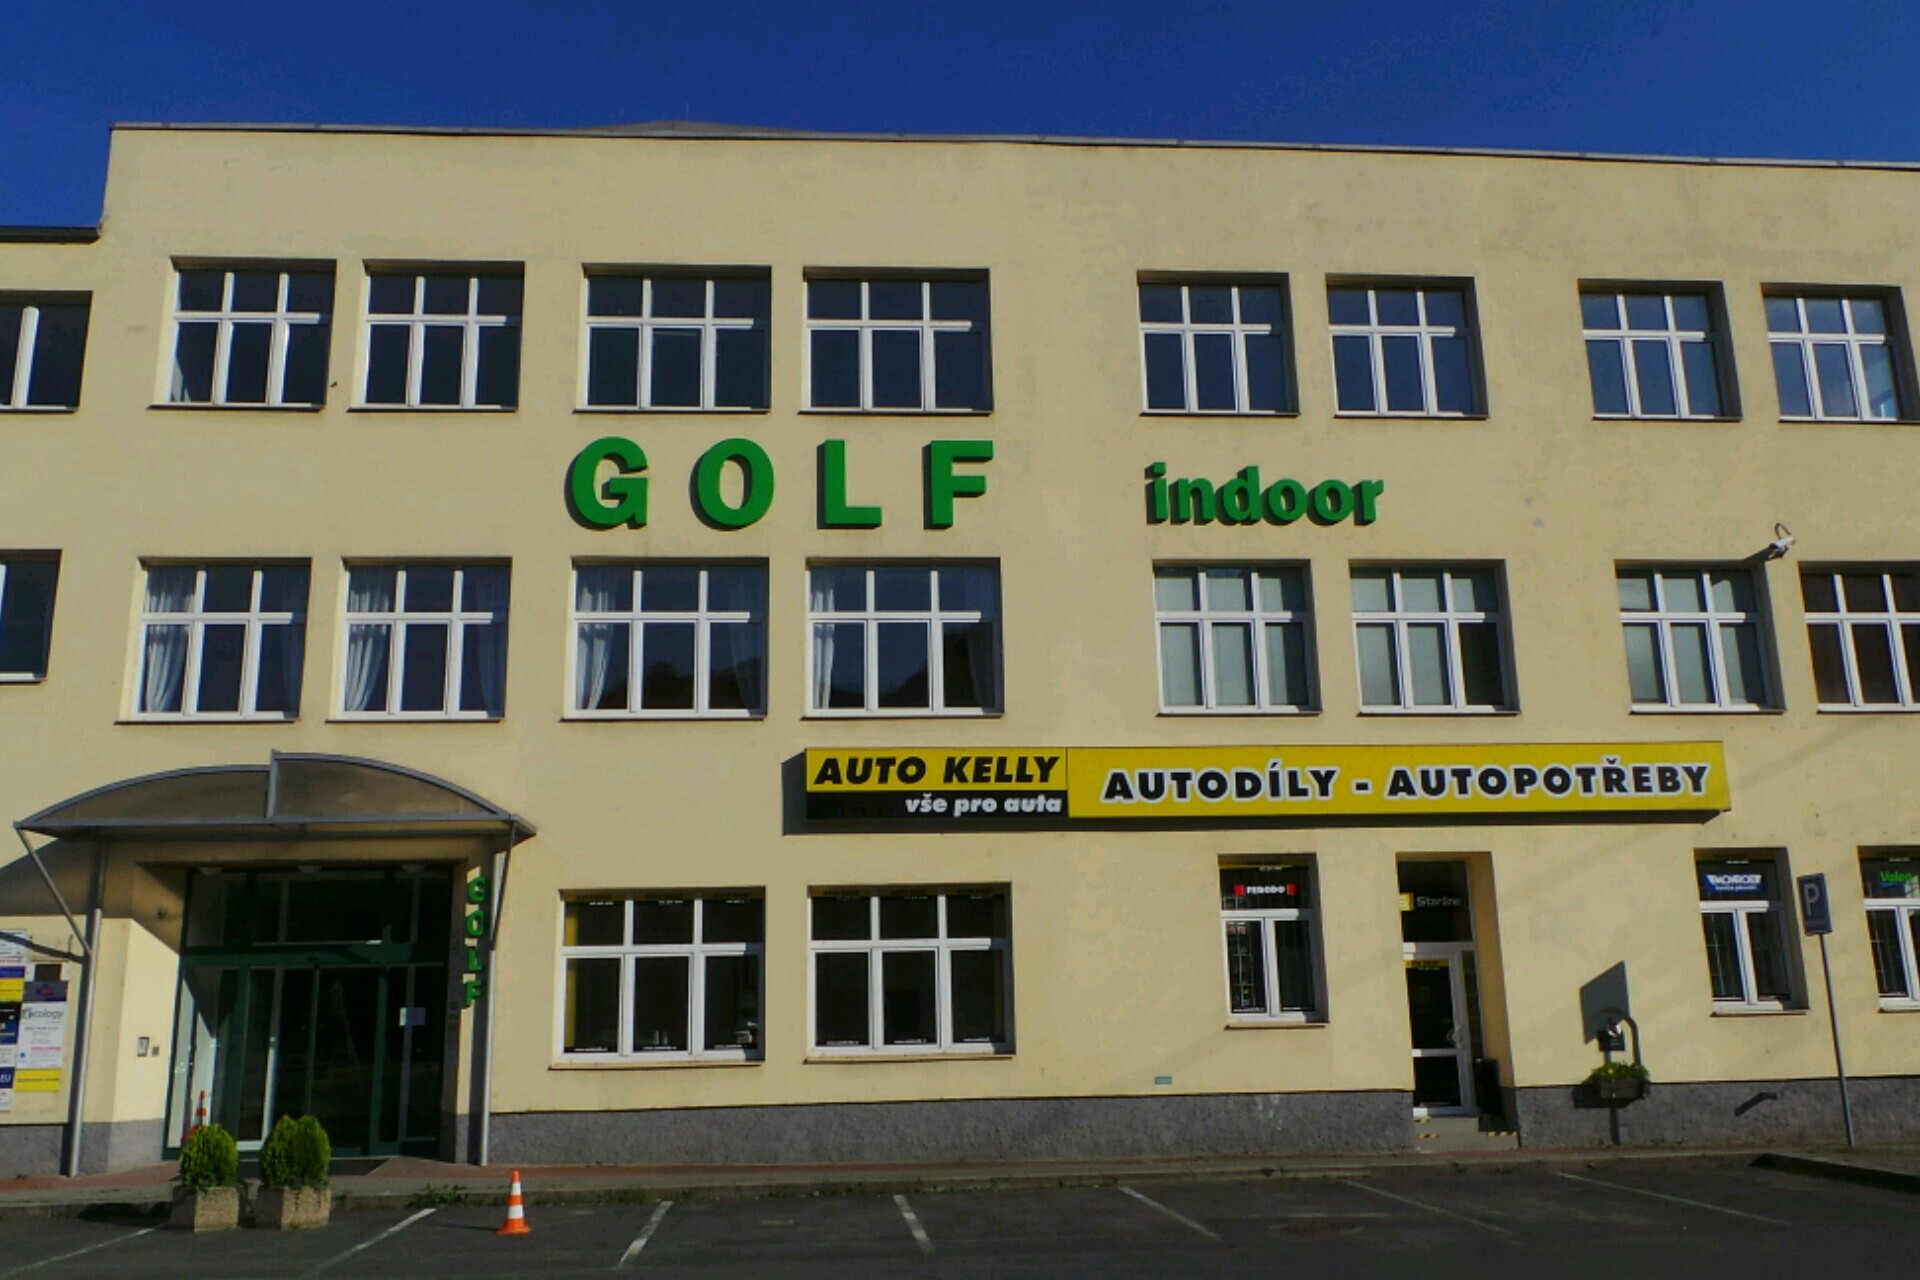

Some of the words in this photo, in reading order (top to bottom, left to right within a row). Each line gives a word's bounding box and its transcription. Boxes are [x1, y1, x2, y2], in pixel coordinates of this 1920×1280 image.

[566, 437, 993, 530] GOLF
[1145, 462, 1384, 525] indoor
[814, 757, 926, 784] AUTO
[943, 756, 1060, 783] KELLY
[1103, 761, 1337, 800] AUTODÍLY
[1386, 757, 1708, 797] AUTOPOTŘEBY
[905, 793, 947, 813] vše
[954, 798, 997, 817] pro
[1003, 795, 1062, 813] auta
[1804, 883, 1820, 915] P
[465, 876, 488, 1007] GOLF
